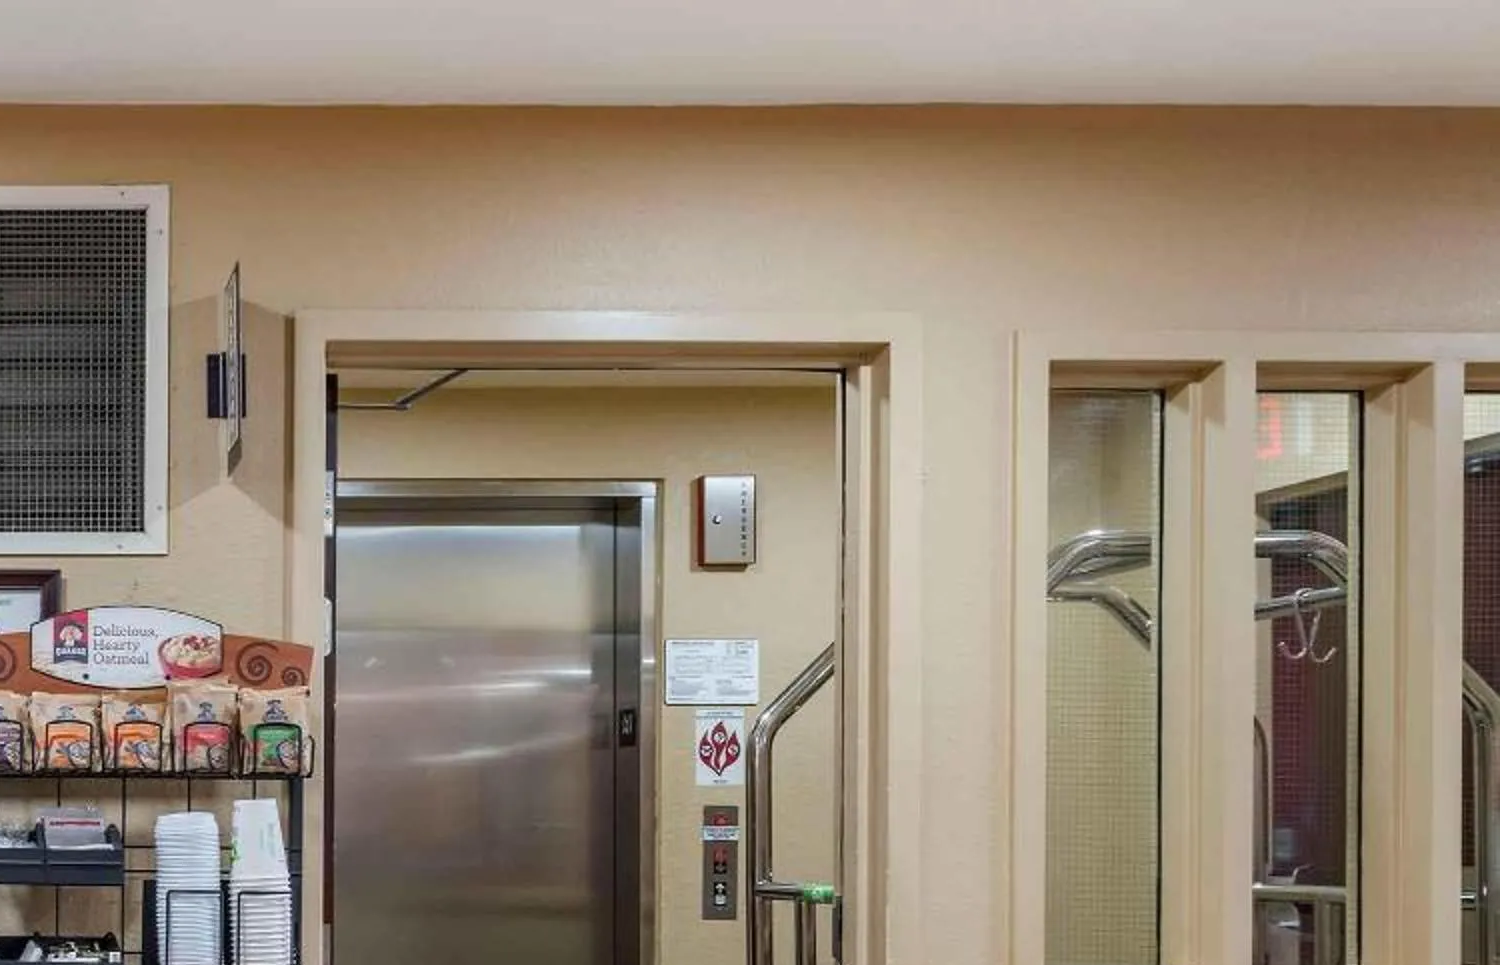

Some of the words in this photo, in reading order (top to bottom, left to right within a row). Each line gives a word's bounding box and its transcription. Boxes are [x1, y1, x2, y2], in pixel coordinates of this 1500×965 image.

[93, 623, 159, 639] Delicious,
[93, 639, 141, 653] Hearty
[93, 651, 149, 665] Oatmeal
